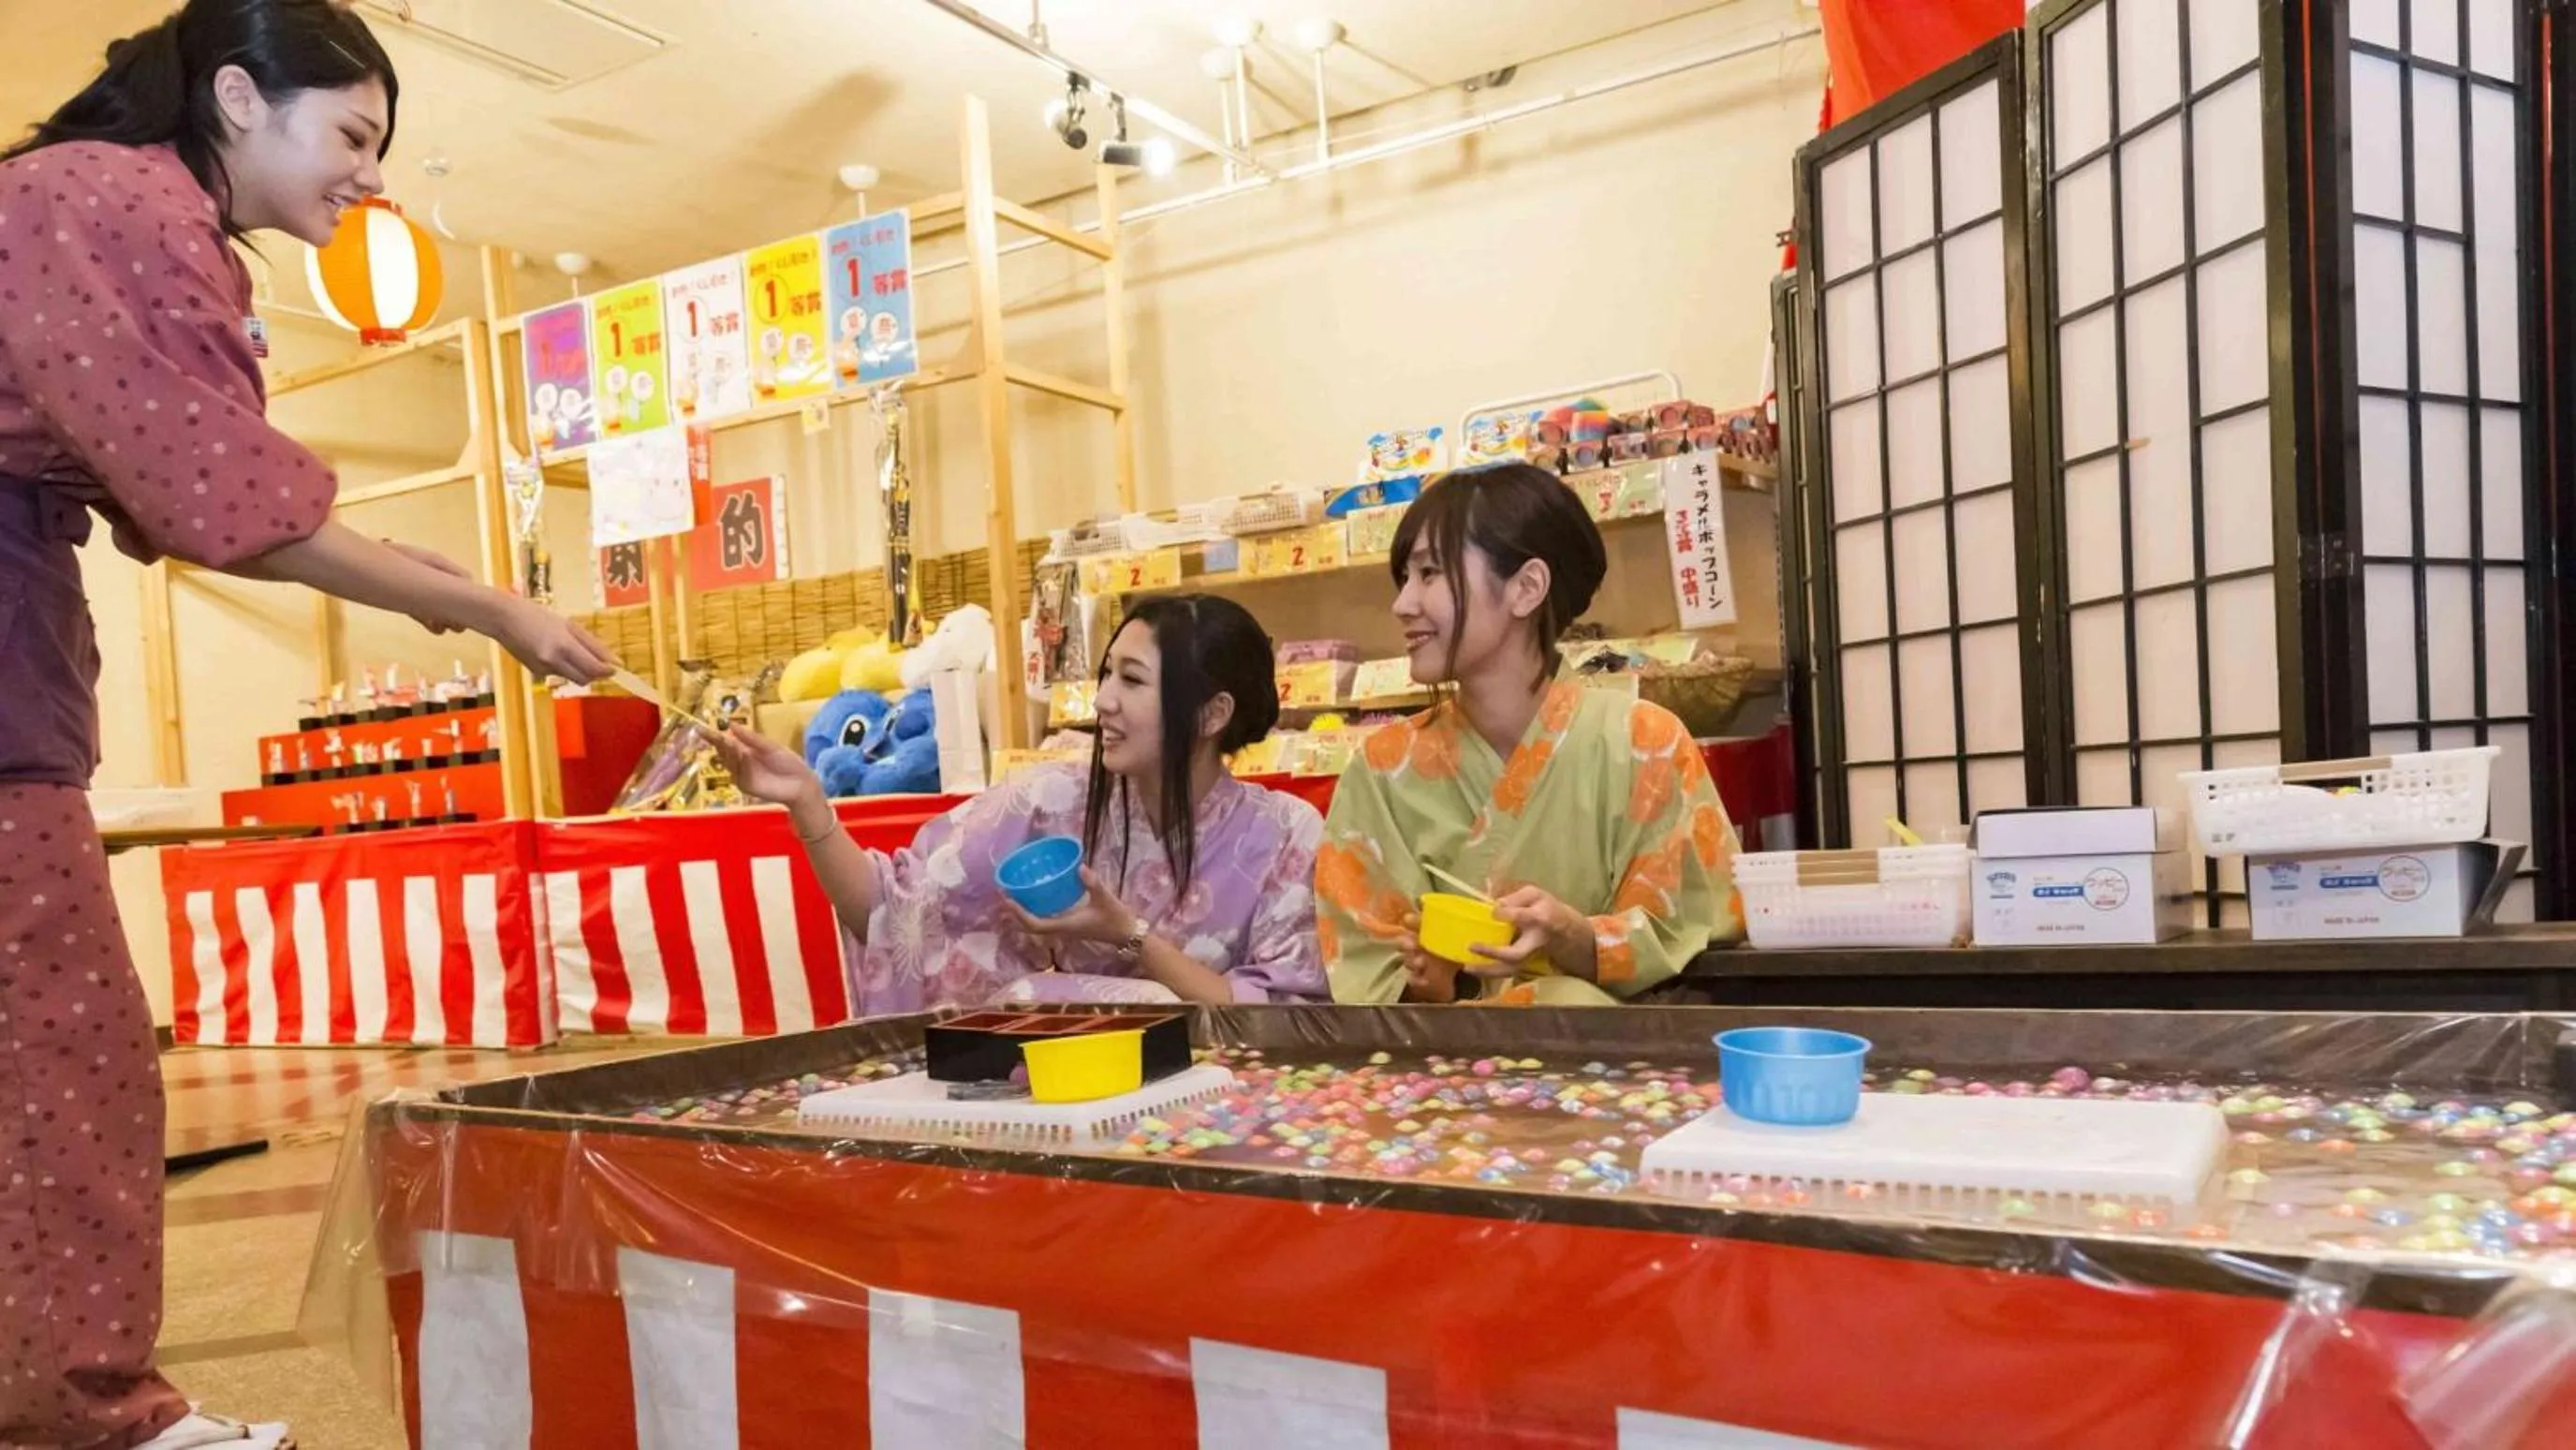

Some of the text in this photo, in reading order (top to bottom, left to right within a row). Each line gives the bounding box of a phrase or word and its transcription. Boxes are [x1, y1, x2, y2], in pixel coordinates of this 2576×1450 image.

[846, 259, 861, 298] 1
[765, 279, 776, 318] 1
[686, 301, 698, 338] 1
[611, 322, 622, 358] 1
[1292, 545, 1304, 567] 2
[1130, 567, 1141, 587] 2
[1280, 682, 1292, 702] 2
